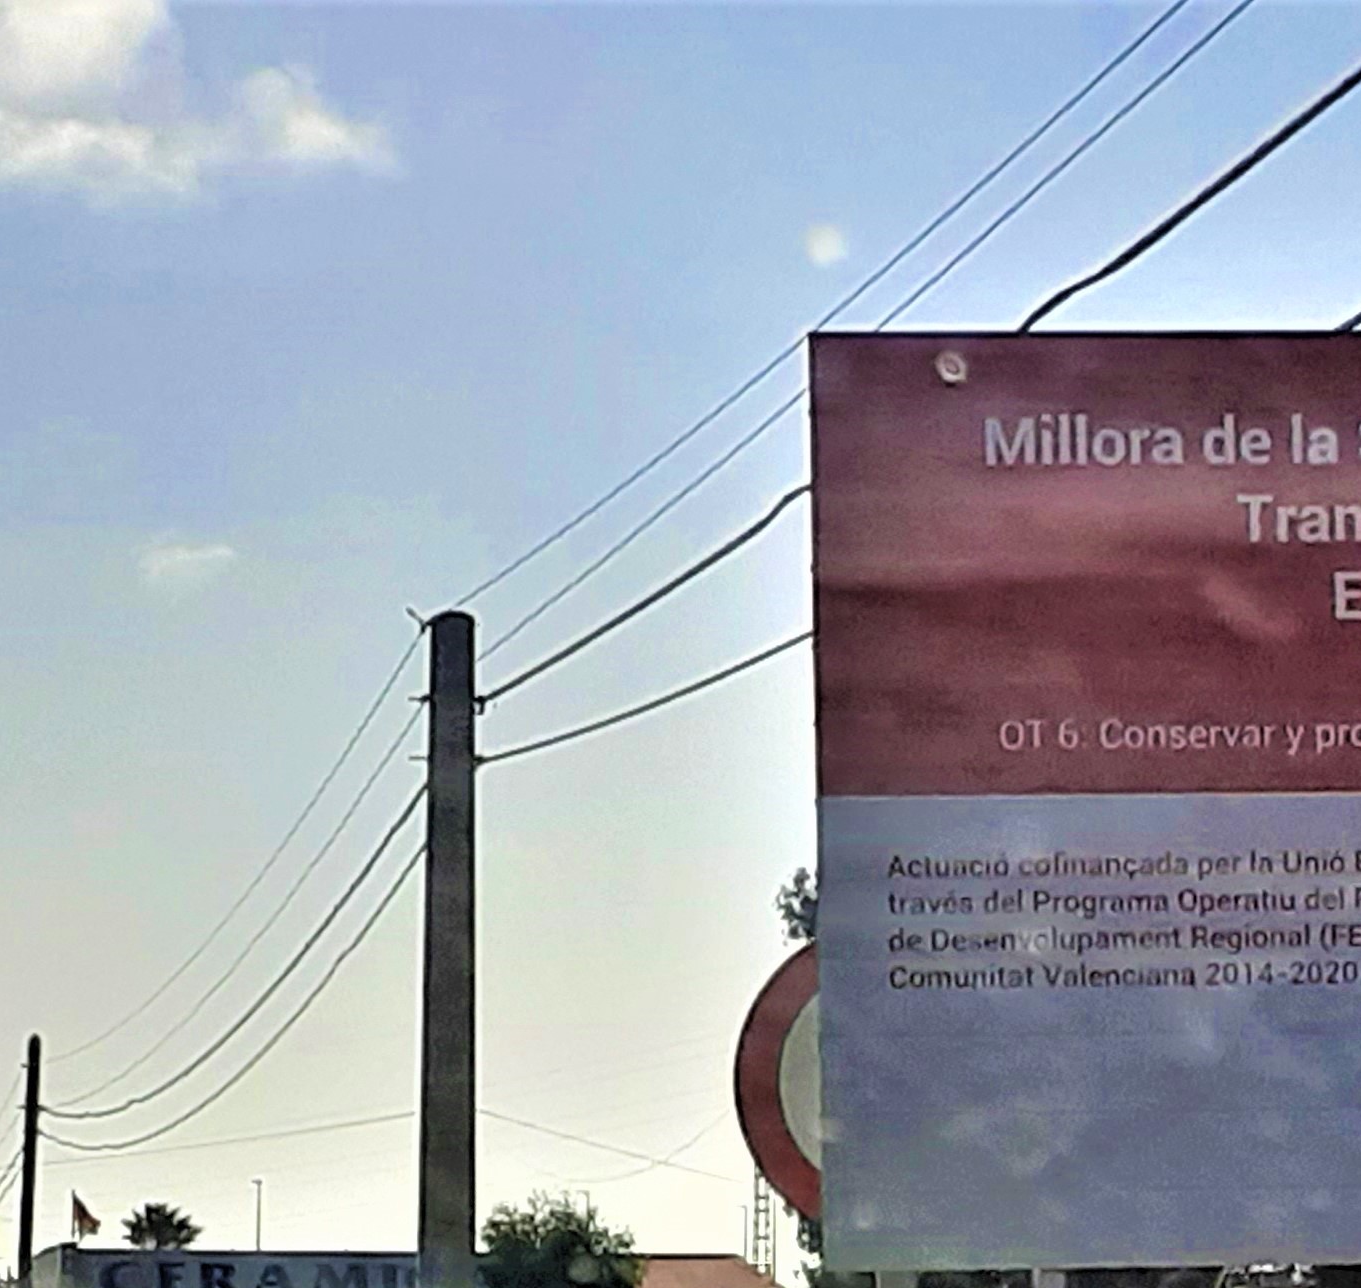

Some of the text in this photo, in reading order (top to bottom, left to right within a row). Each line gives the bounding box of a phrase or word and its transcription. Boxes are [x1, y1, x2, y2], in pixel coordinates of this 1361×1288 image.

[983, 414, 1184, 468] Millora
[1204, 414, 1271, 466] de
[1290, 414, 1340, 466] la
[1000, 719, 1046, 752] OT
[1099, 718, 1275, 752] Conservar
[1285, 725, 1304, 756] y
[888, 854, 1009, 879] Actuació
[1198, 853, 1242, 880] per
[1250, 850, 1273, 873] la
[1283, 850, 1345, 874] Unió
[888, 891, 973, 915] través
[983, 888, 1023, 913] del
[1033, 889, 1168, 919] Programa
[1178, 887, 1295, 917] Operatiu
[1304, 887, 1345, 911] del
[888, 927, 922, 952] de
[1191, 924, 1309, 955] Regional
[890, 964, 1033, 990] Comunitat
[1043, 963, 1196, 989] Valenciana
